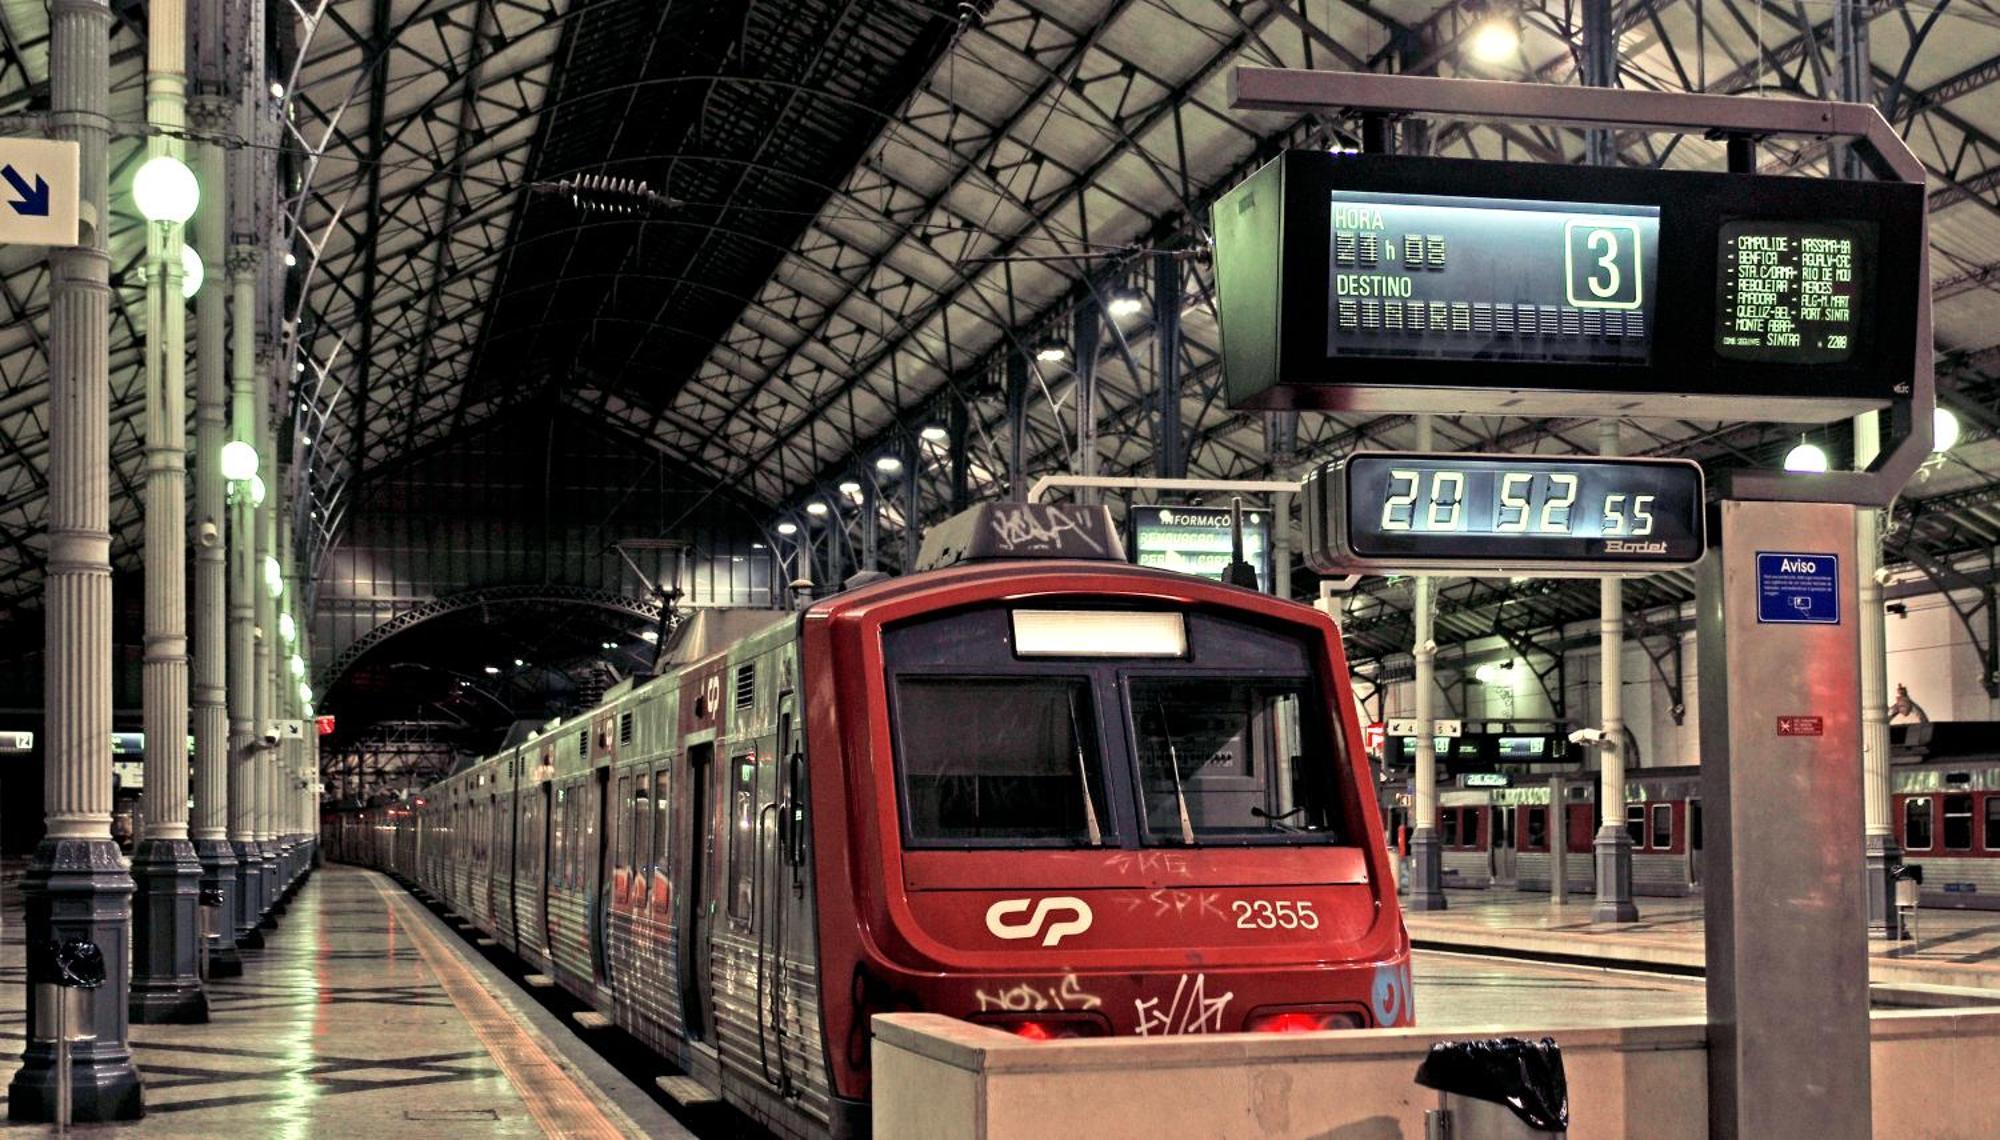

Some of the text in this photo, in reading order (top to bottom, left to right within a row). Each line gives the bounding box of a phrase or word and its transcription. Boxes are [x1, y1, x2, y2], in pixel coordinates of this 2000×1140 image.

[1335, 206, 1384, 230] HORA
[1384, 239, 1395, 260] h
[1737, 235, 1788, 252] CAMPOLIDE
[1587, 229, 1621, 298] 3
[1737, 251, 1778, 265] BENFICA
[1802, 267, 1819, 281] RIO
[1822, 268, 1833, 281] DE
[1337, 274, 1412, 298] DESTINO
[1737, 279, 1788, 293] REBOLEIRA
[1737, 292, 1777, 305] AMADORA
[1735, 318, 1764, 332] MONTE
[1766, 332, 1801, 347] SINTRA
[1381, 470, 1656, 536] 20 52 55
[1603, 540, 1667, 554] Bodet
[1780, 558, 1816, 573] Aviso
[1231, 900, 1319, 931] 2355
